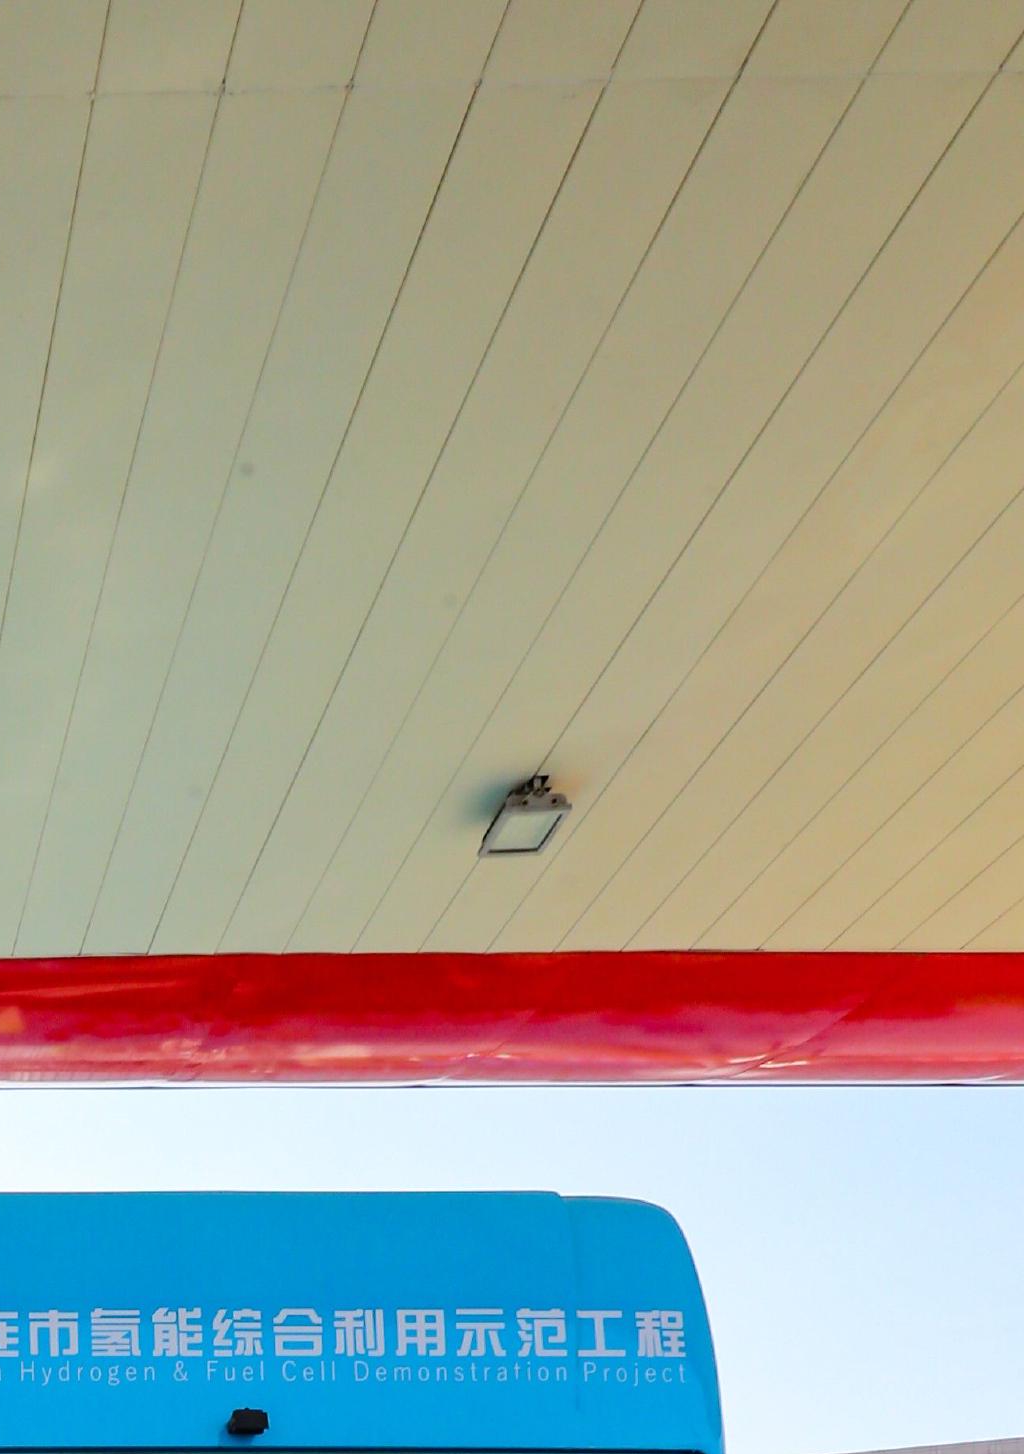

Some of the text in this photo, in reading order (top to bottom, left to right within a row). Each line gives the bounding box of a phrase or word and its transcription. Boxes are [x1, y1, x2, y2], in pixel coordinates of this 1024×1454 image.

[21, 1361, 156, 1386] Hydrogen
[173, 1361, 189, 1381] &
[207, 1360, 265, 1381] Fuel
[282, 1360, 337, 1382] Cell
[354, 1361, 568, 1382] Demonstration
[584, 1361, 687, 1386] Project
